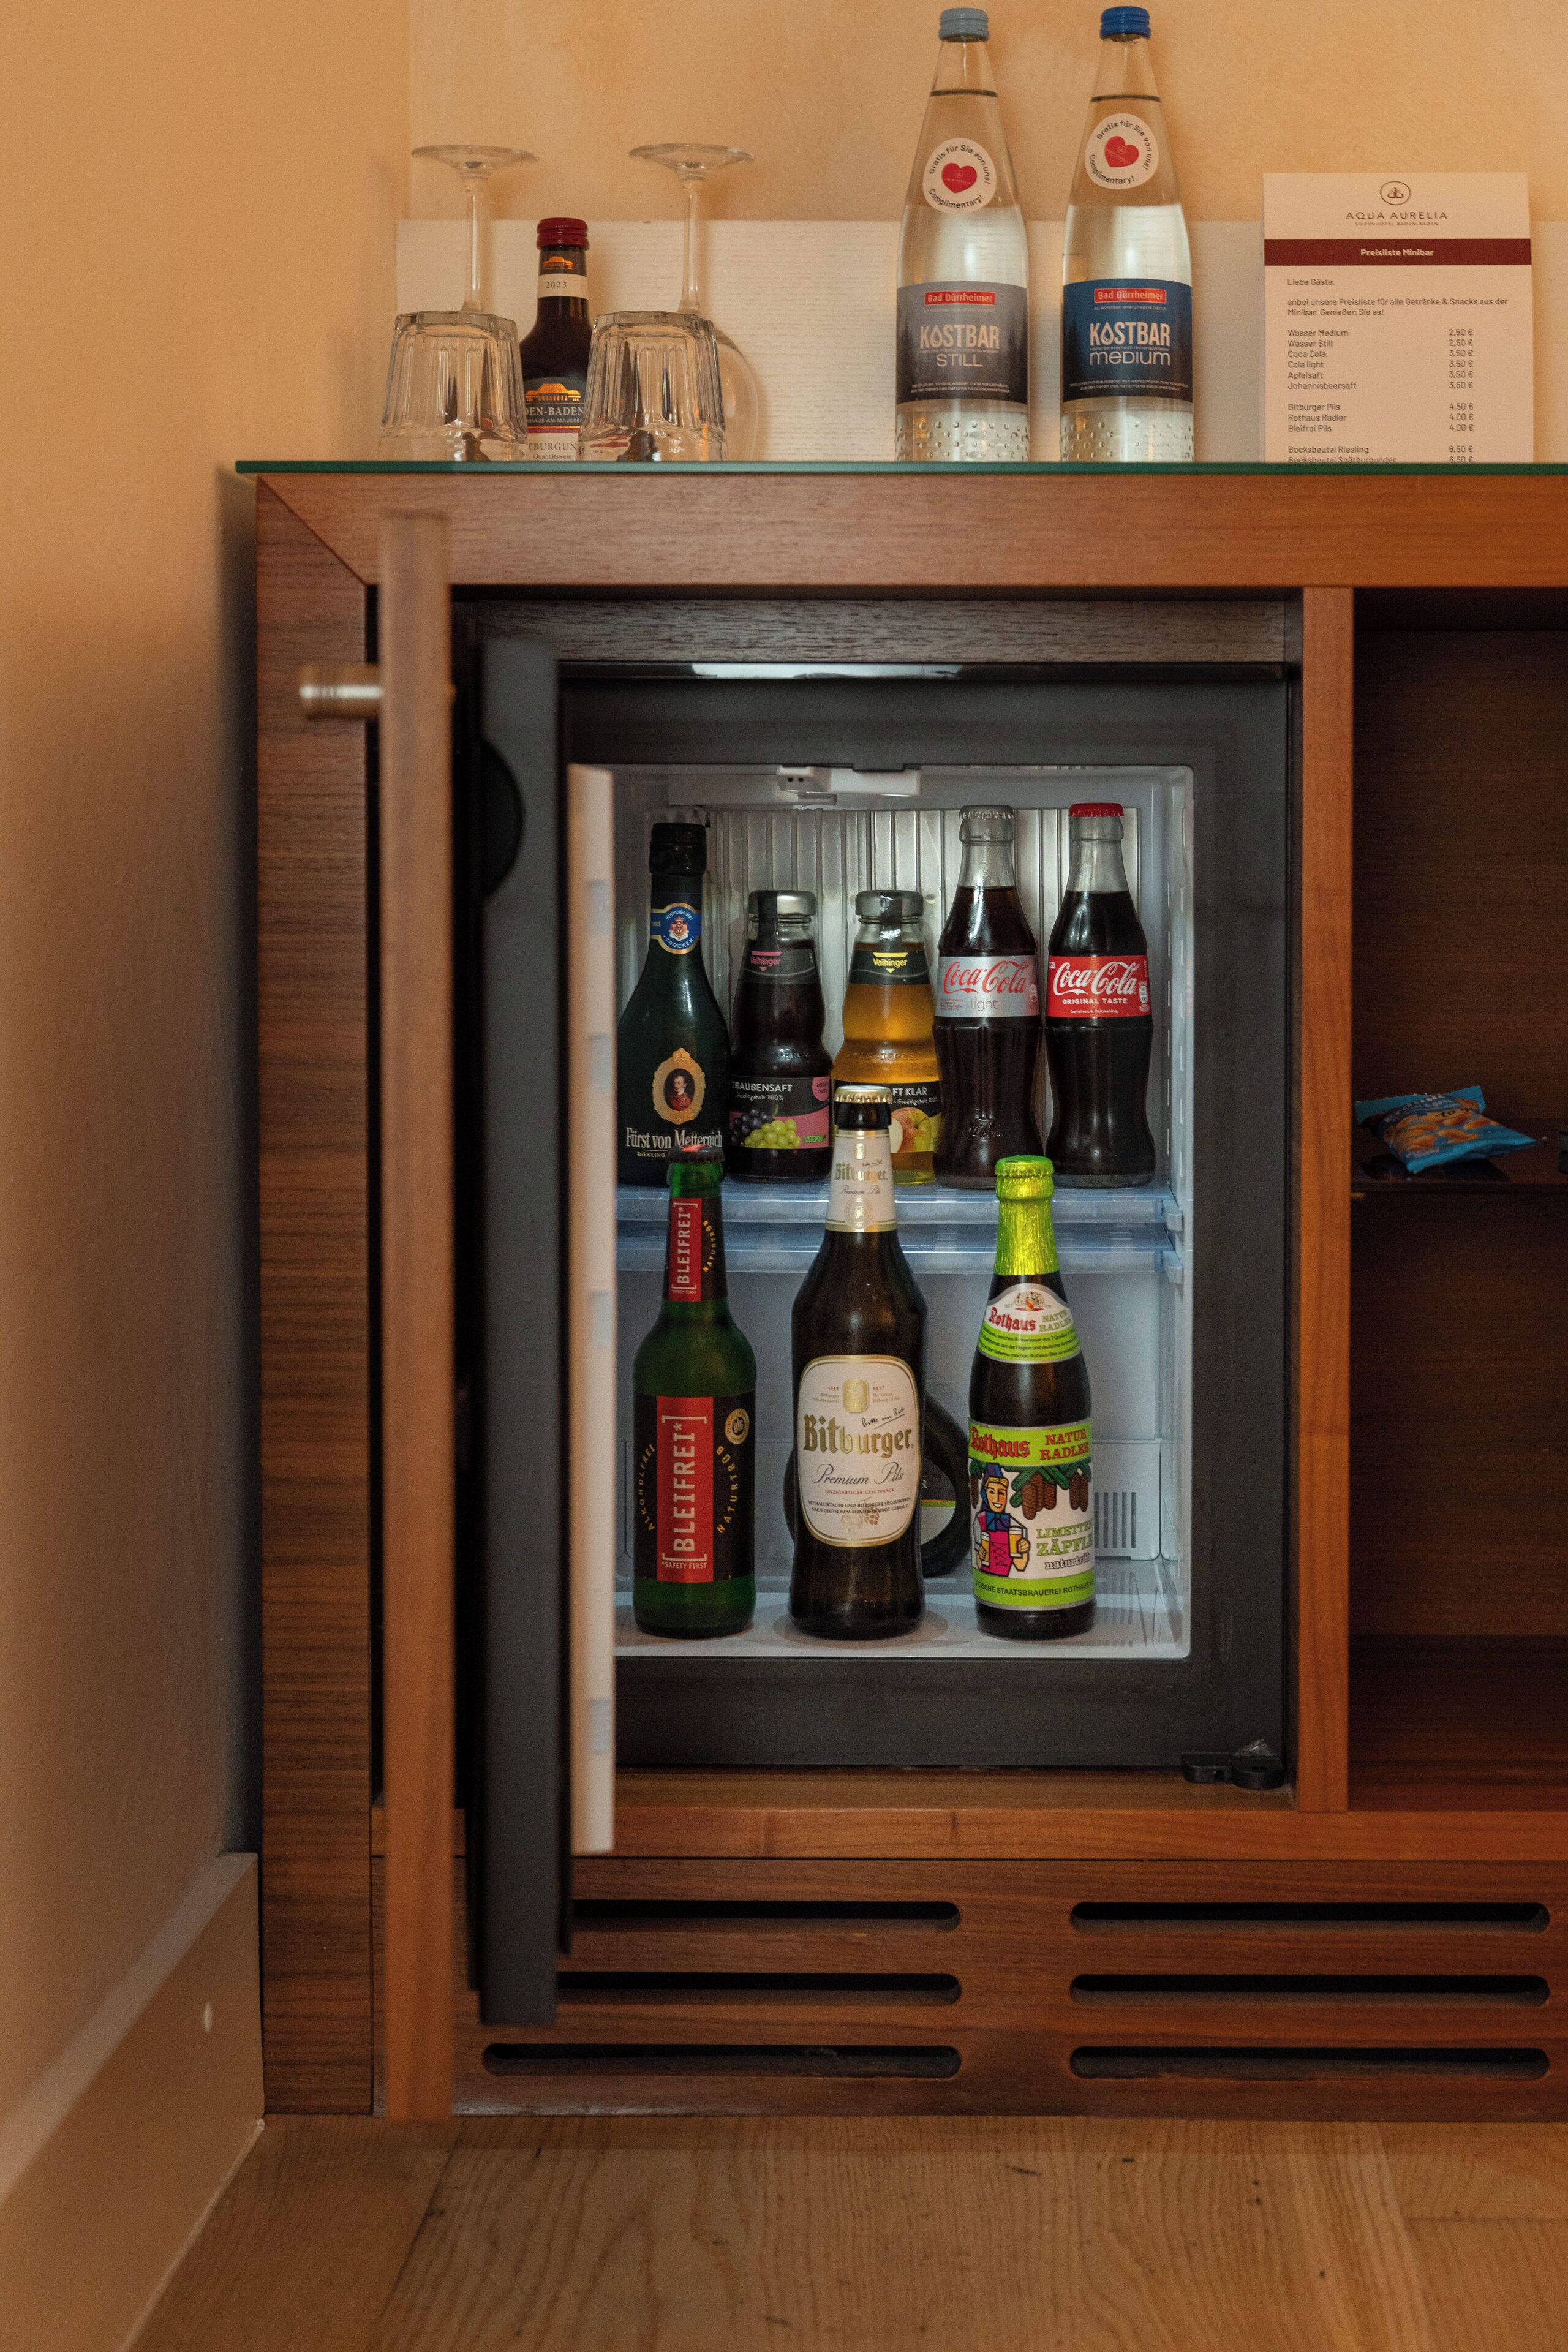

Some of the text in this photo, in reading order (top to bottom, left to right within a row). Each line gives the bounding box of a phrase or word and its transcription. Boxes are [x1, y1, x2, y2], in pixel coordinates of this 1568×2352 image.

[1096, 123, 1118, 140] Gratis
[1133, 124, 1145, 137] Sie
[1143, 138, 1152, 152] von
[929, 152, 946, 175] Gratis
[946, 145, 959, 154] für
[960, 144, 973, 154] Sie
[974, 152, 986, 165] von
[1142, 153, 1152, 171] uns!
[1089, 154, 1135, 184] Complimentary!
[929, 188, 985, 209] Complimentary!
[546, 281, 567, 289] 2023
[1310, 278, 1335, 287] Gäste,
[927, 293, 993, 303] Bad Dürrheimer
[1098, 290, 1164, 300] Bad Dürrheimer
[920, 324, 1000, 349] KOSTBAR
[1090, 322, 1170, 347] KOSTBAR
[936, 353, 983, 367] STILL
[1306, 361, 1324, 370] light
[1287, 371, 1323, 380] Apfelsaft
[1288, 403, 1325, 412] Bitburger
[1338, 446, 1370, 455] Riesling
[665, 937, 694, 949] TROCKEN
[872, 958, 908, 968] Vaihinger
[943, 960, 1029, 995] Coca-Cola
[1053, 961, 1140, 996] Coca-Cola
[970, 996, 1000, 1012] light
[731, 1081, 793, 1093] TRAUBENSAFT
[905, 1087, 927, 1096] KLAR
[625, 1127, 723, 1149] Fürst von Metternich
[835, 1163, 887, 1183] Bitburger
[839, 1185, 865, 1195] Premium
[989, 1307, 1036, 1332] Rothaus
[861, 1417, 879, 1427] Bitte
[893, 1407, 905, 1416] Bit
[804, 1414, 912, 1458] Bitburger
[971, 1426, 1030, 1460] Rothaus
[1045, 1428, 1087, 1446] NATUR
[1039, 1442, 1089, 1460] RADLER
[811, 1463, 870, 1485] Premium
[873, 1461, 904, 1485] Pils
[639, 1443, 656, 1531] ALKOHOLFREI
[716, 1446, 737, 1534] NATURTRÜB
[996, 1588, 1061, 1596] STAATSBRAUEREI
[1063, 1582, 1089, 1593] ROTHAUS
